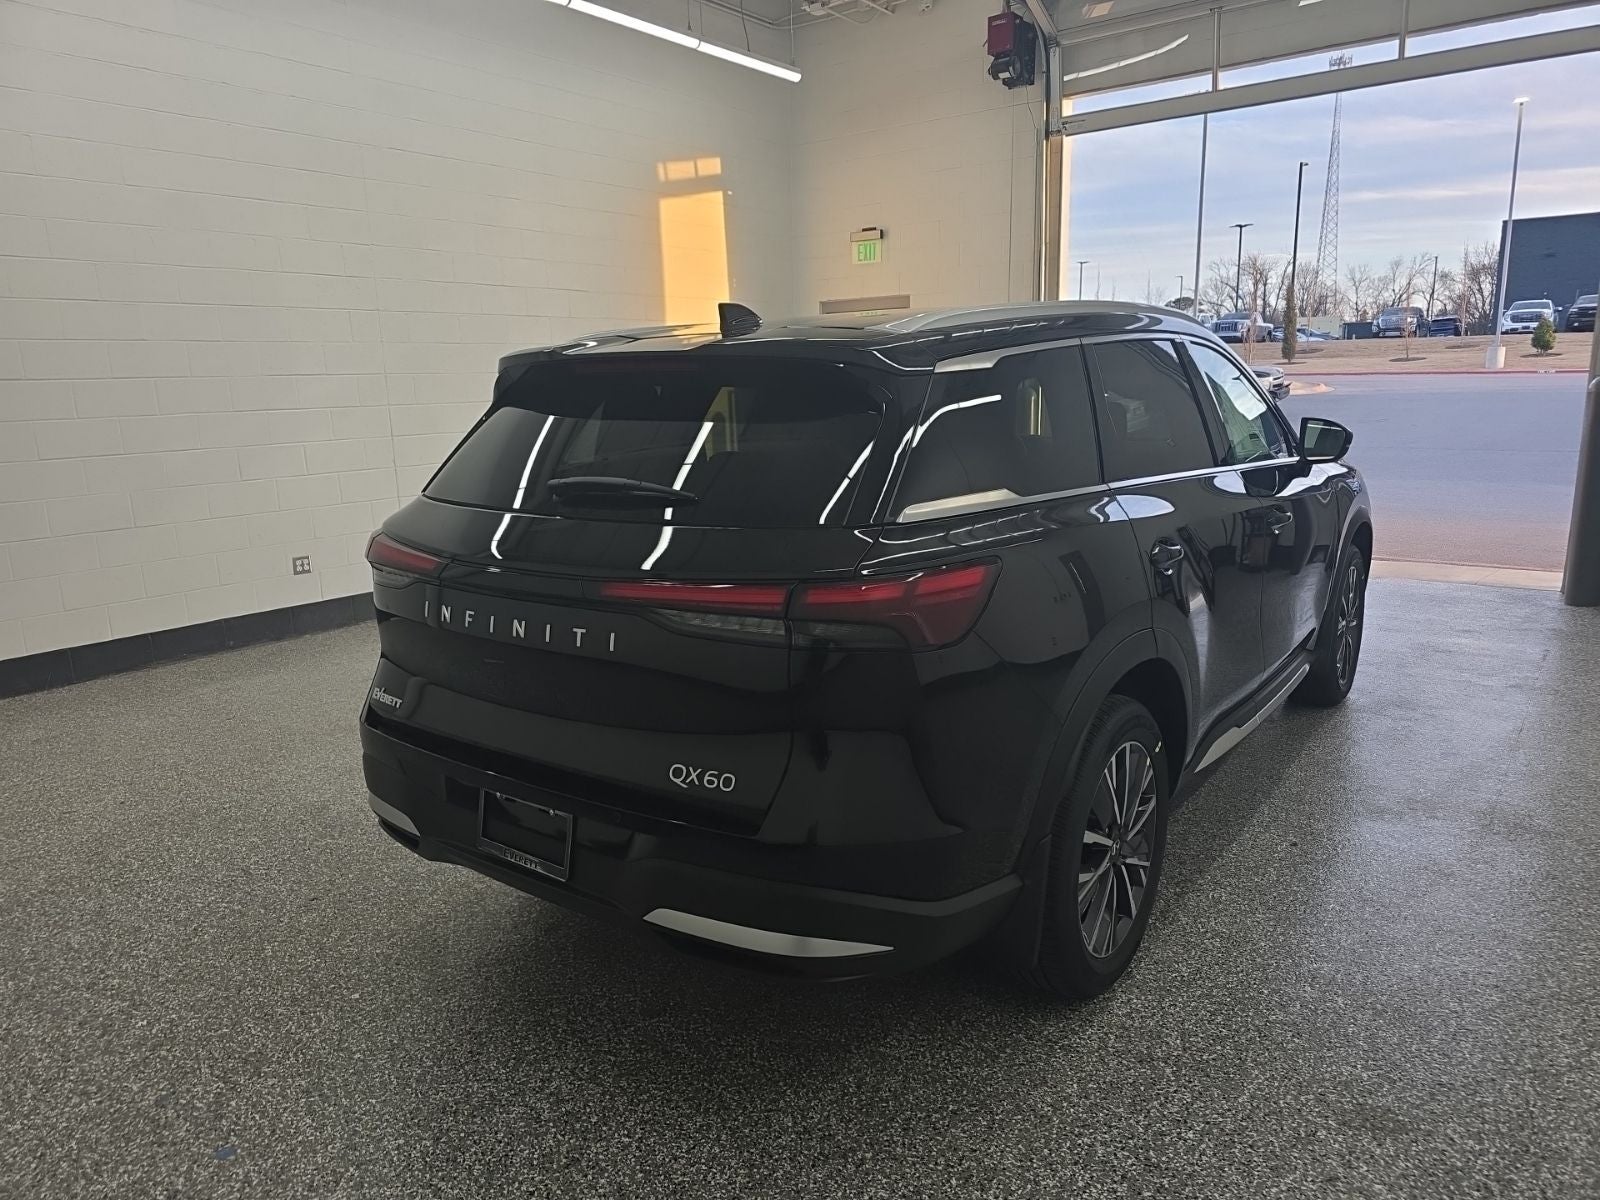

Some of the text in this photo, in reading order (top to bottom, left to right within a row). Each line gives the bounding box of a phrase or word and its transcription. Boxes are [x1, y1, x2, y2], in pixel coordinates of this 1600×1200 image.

[857, 242, 877, 262] EXIT
[424, 600, 616, 652] INFINITI
[372, 687, 403, 709] EVERETT
[669, 763, 736, 792] QX60
